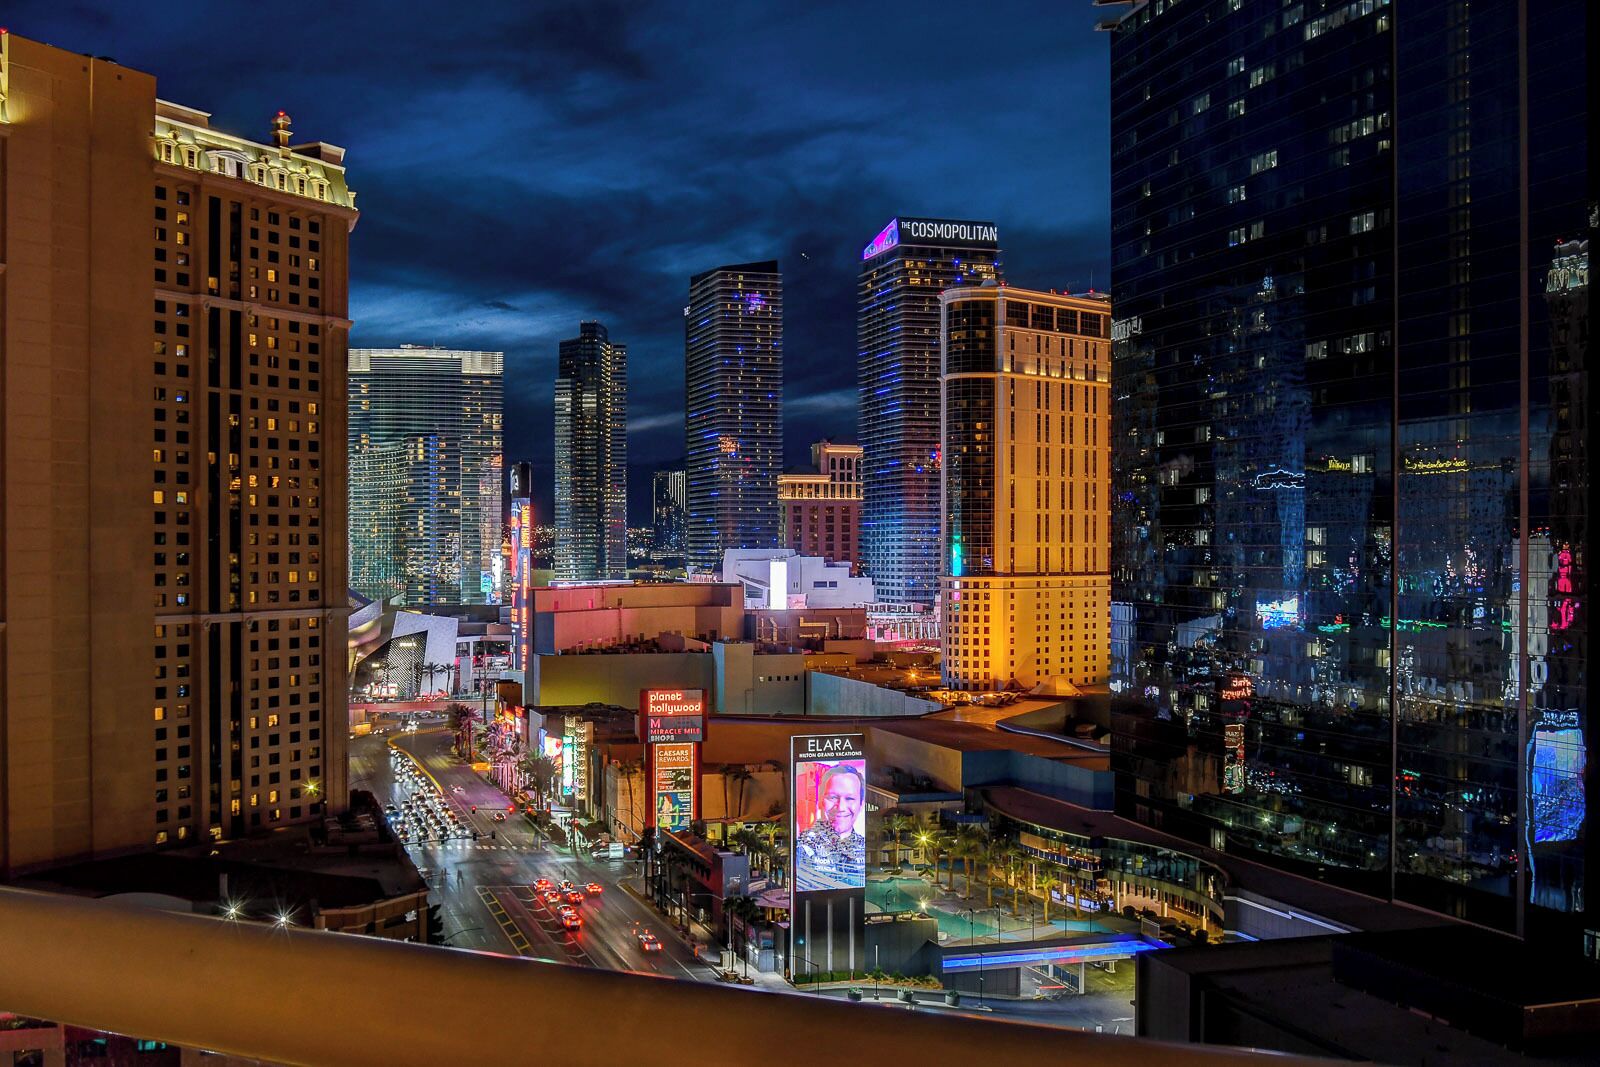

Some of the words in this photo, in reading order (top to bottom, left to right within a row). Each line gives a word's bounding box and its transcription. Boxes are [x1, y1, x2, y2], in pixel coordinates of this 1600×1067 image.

[901, 221, 911, 230] THE
[911, 222, 997, 241] COSMOPOLITAN
[650, 692, 682, 703] planet
[650, 702, 701, 714] hollywood
[683, 727, 700, 735] MILE
[650, 734, 675, 742] SHOPS
[808, 739, 853, 752] ELARA
[658, 749, 689, 757] CAESARS
